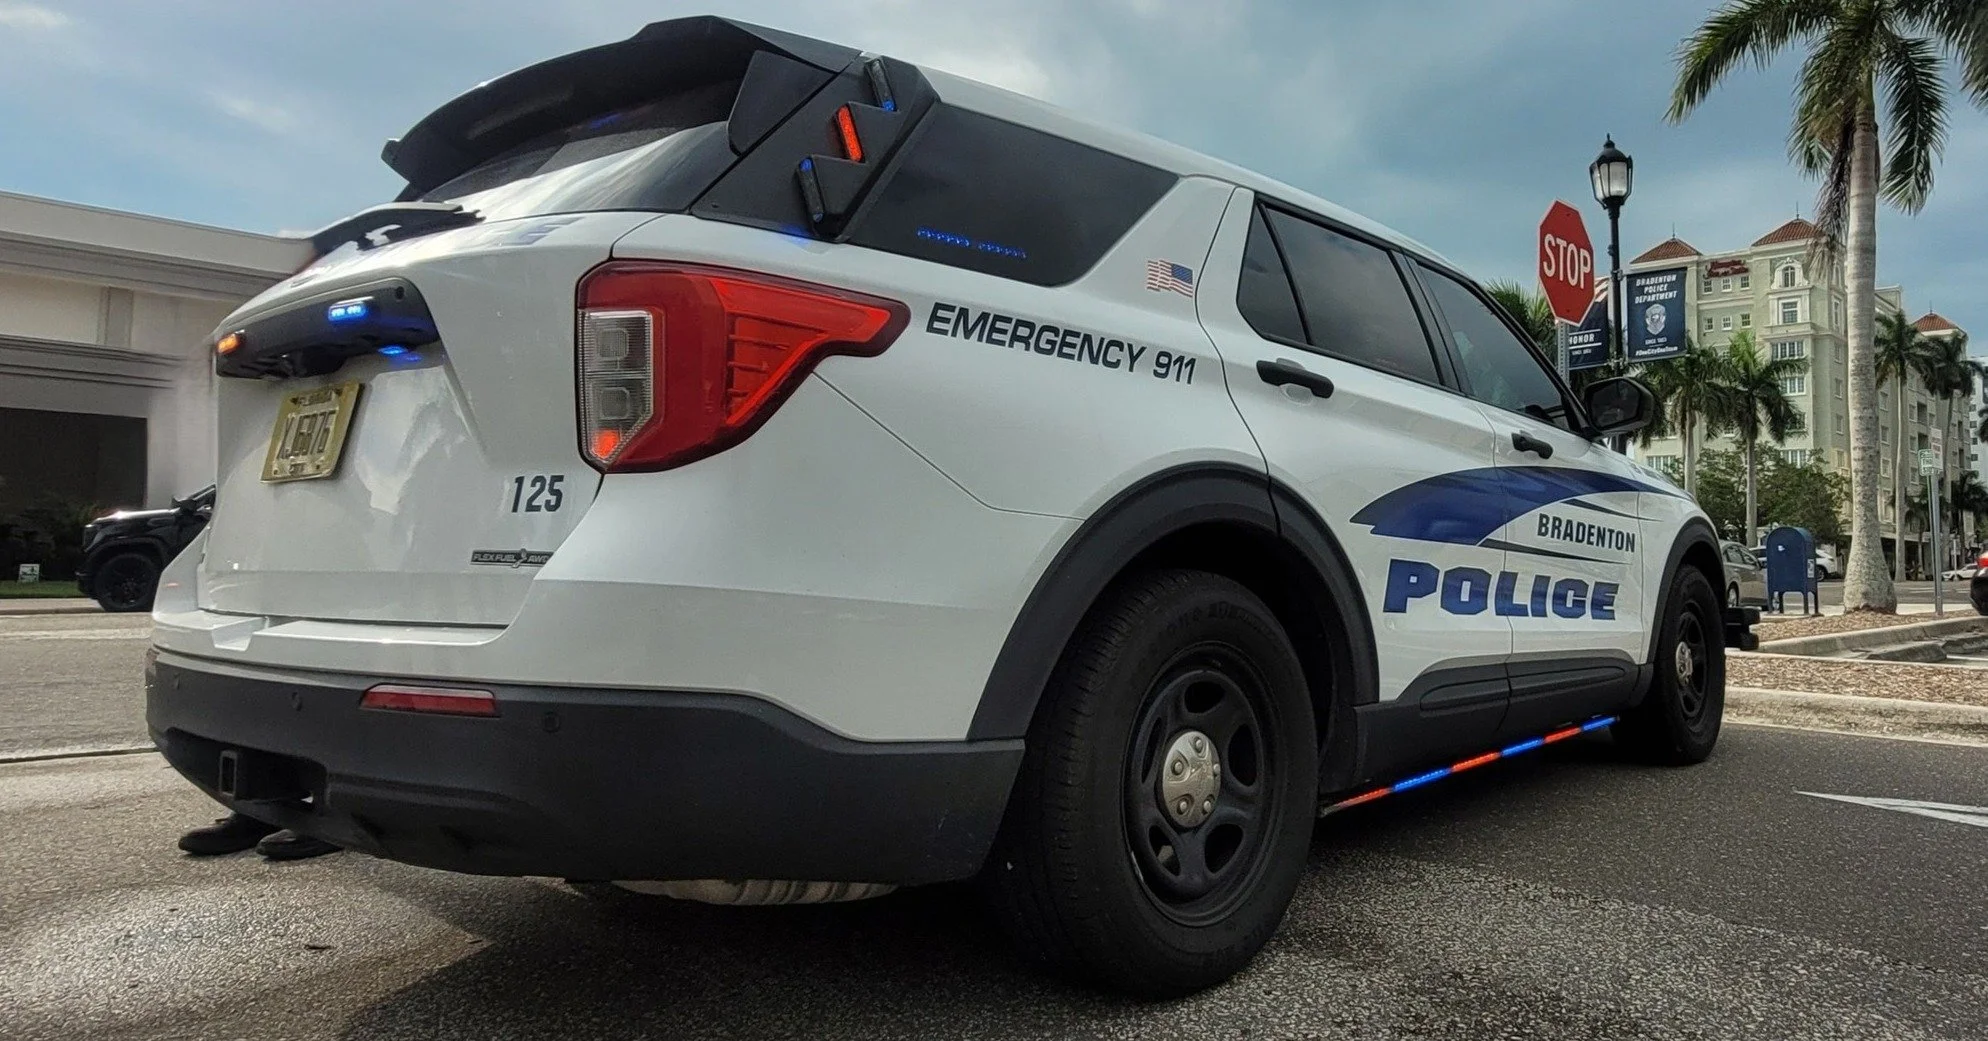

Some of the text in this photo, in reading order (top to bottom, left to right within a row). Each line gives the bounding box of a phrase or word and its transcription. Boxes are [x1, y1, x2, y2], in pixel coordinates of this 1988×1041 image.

[1543, 233, 1591, 290] STOP
[1635, 274, 1677, 287] BRADENTON
[1634, 290, 1678, 304] DEPARTMENT
[1643, 283, 1669, 294] POLICE
[926, 302, 1197, 385] EMERGENCY 911
[511, 474, 565, 513] 125
[1537, 513, 1635, 553] BRADENTON
[472, 552, 495, 562] FLEX
[495, 553, 517, 562] FUEL
[1382, 558, 1620, 621] POLICE
